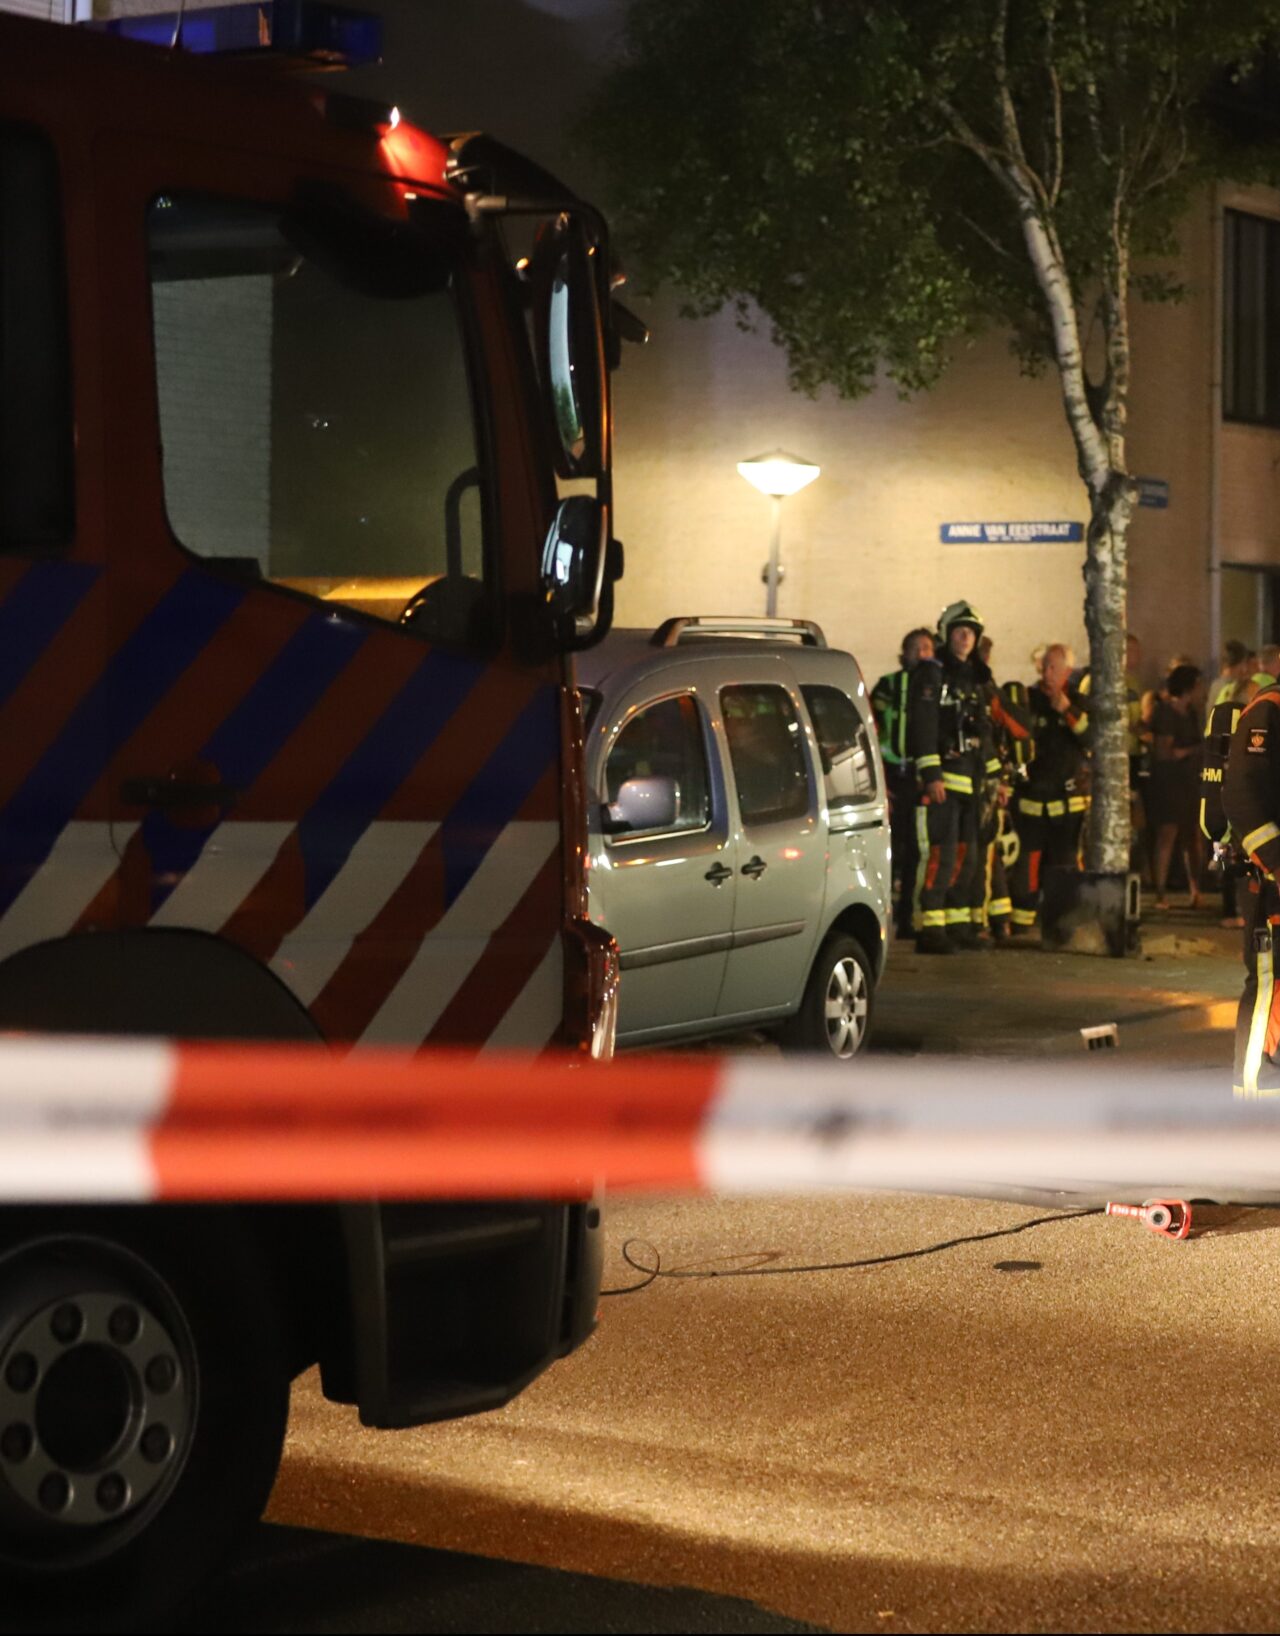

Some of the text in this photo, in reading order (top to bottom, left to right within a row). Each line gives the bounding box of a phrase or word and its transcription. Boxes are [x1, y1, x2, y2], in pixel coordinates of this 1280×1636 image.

[948, 524, 981, 537] ANNIE
[984, 524, 1007, 537] VAN
[1200, 767, 1223, 783] HM
